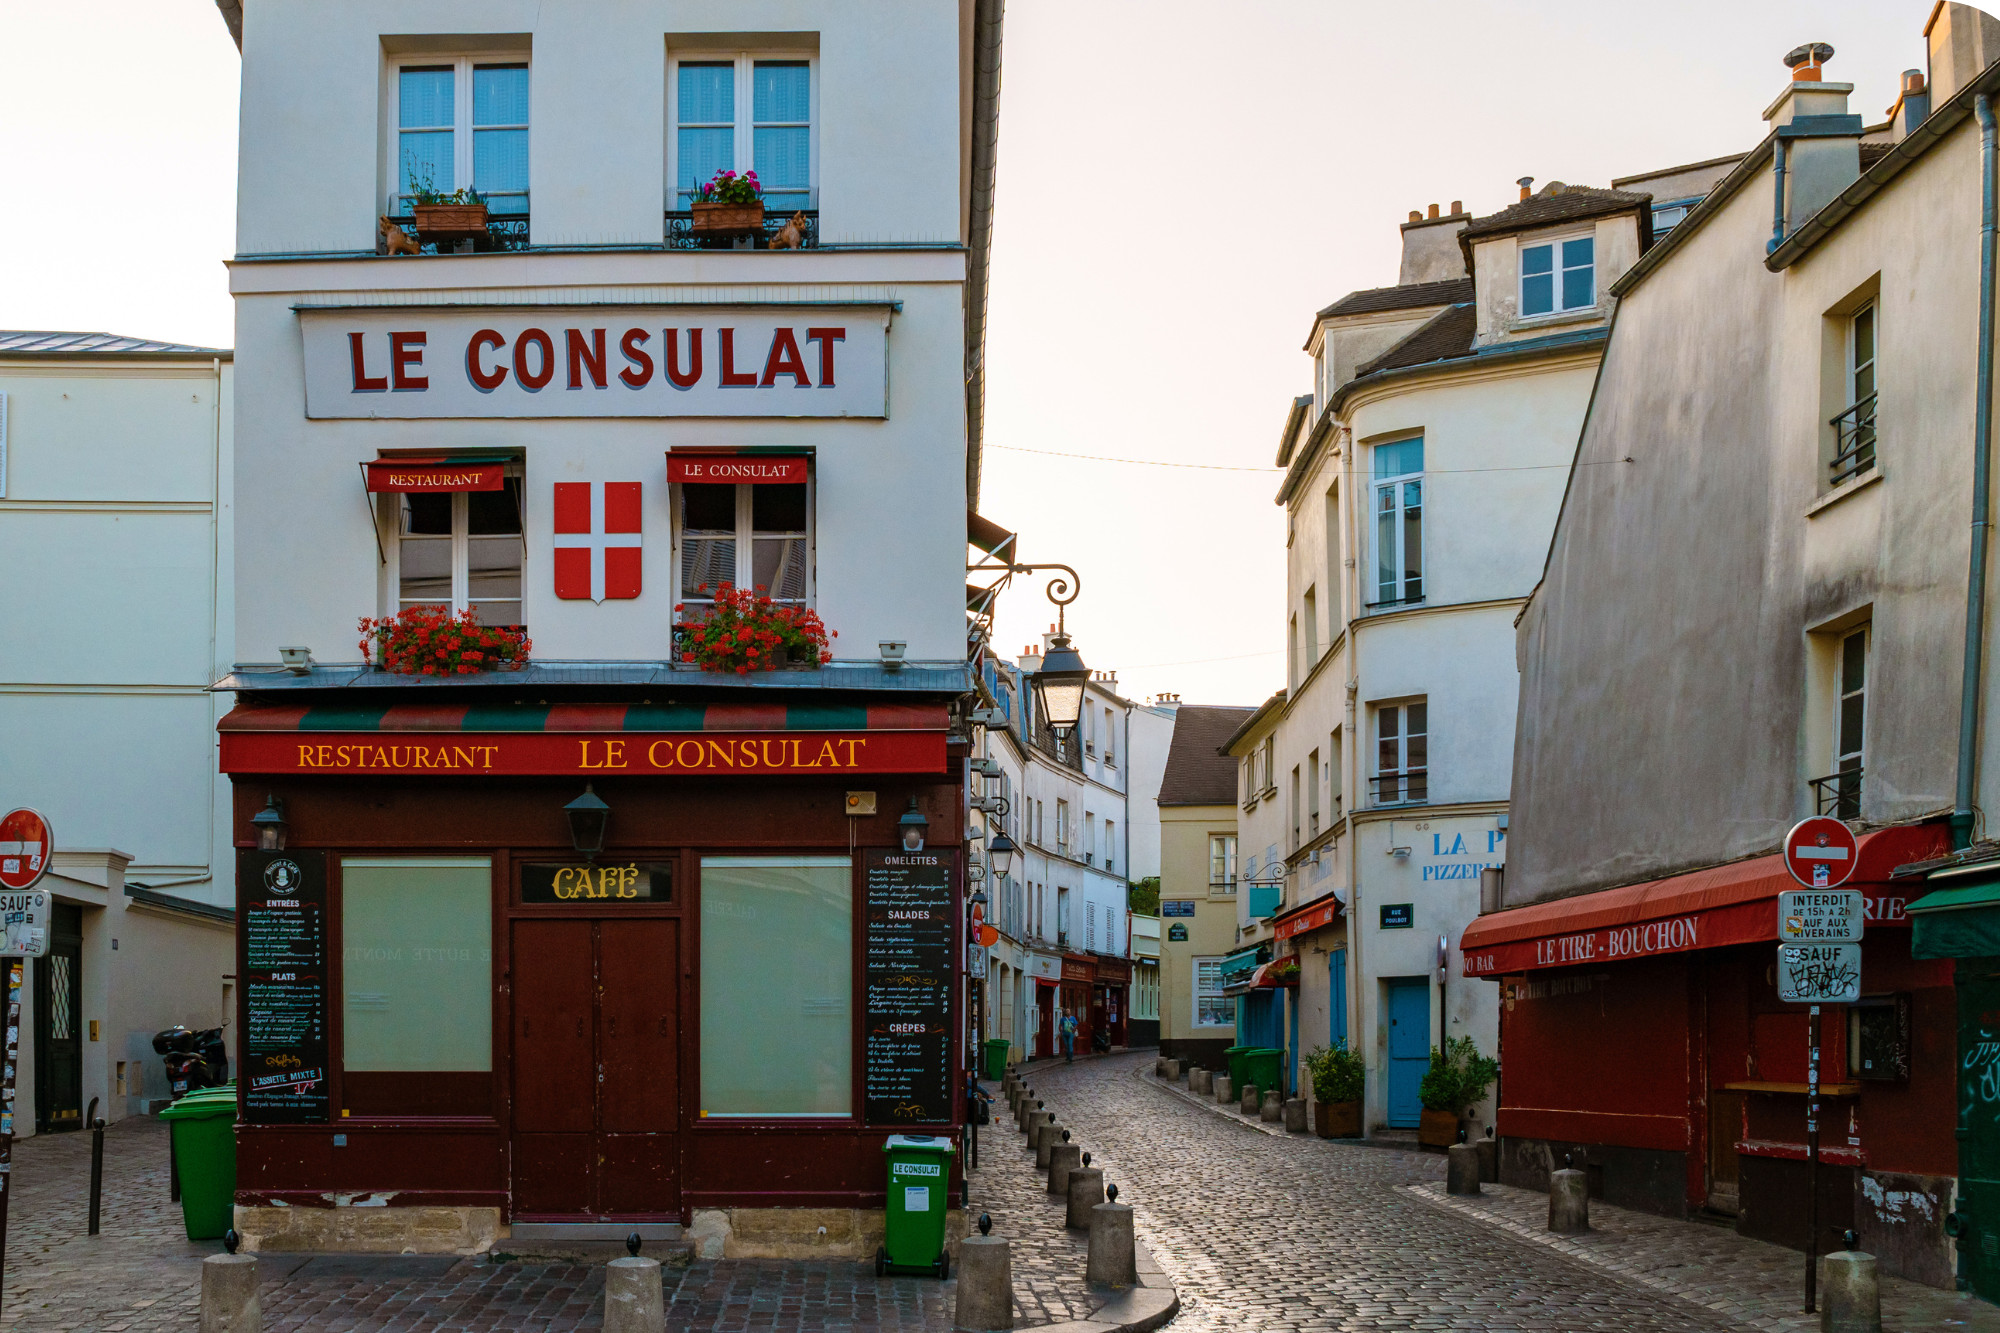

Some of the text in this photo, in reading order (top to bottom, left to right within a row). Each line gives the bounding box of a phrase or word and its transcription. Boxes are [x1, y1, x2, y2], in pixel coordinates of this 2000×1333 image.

[347, 328, 846, 394] LE CONSULAT
[684, 464, 790, 477] LE CONSULAT
[389, 473, 482, 486] RESTAURANT
[297, 745, 499, 768] RESTAURANT
[578, 738, 866, 768] LE CONSULAT
[1433, 832, 1468, 856] LA
[884, 856, 938, 865] OMELETTES
[552, 862, 639, 899] CAFÉ
[0, 896, 32, 911] SAUF
[266, 899, 300, 907] ENTRÉES
[1793, 895, 1851, 906] INTERDIT
[888, 910, 930, 919] SALADES
[1808, 907, 1824, 916] 15h
[1838, 907, 1850, 916] 2h
[1803, 919, 1848, 927] AUF AUX
[1794, 928, 1850, 938] RIVERAINS
[1537, 940, 1555, 964] LE
[1558, 934, 1596, 962] TIRE
[1608, 916, 1699, 957] BOUCHON
[1800, 948, 1842, 962] SAUF
[1476, 955, 1494, 971] BAR
[889, 1022, 926, 1032] CRÊPES
[252, 1070, 316, 1086] L'ASSIETTE MIXTE
[894, 1164, 938, 1175] LE CONSULAT
